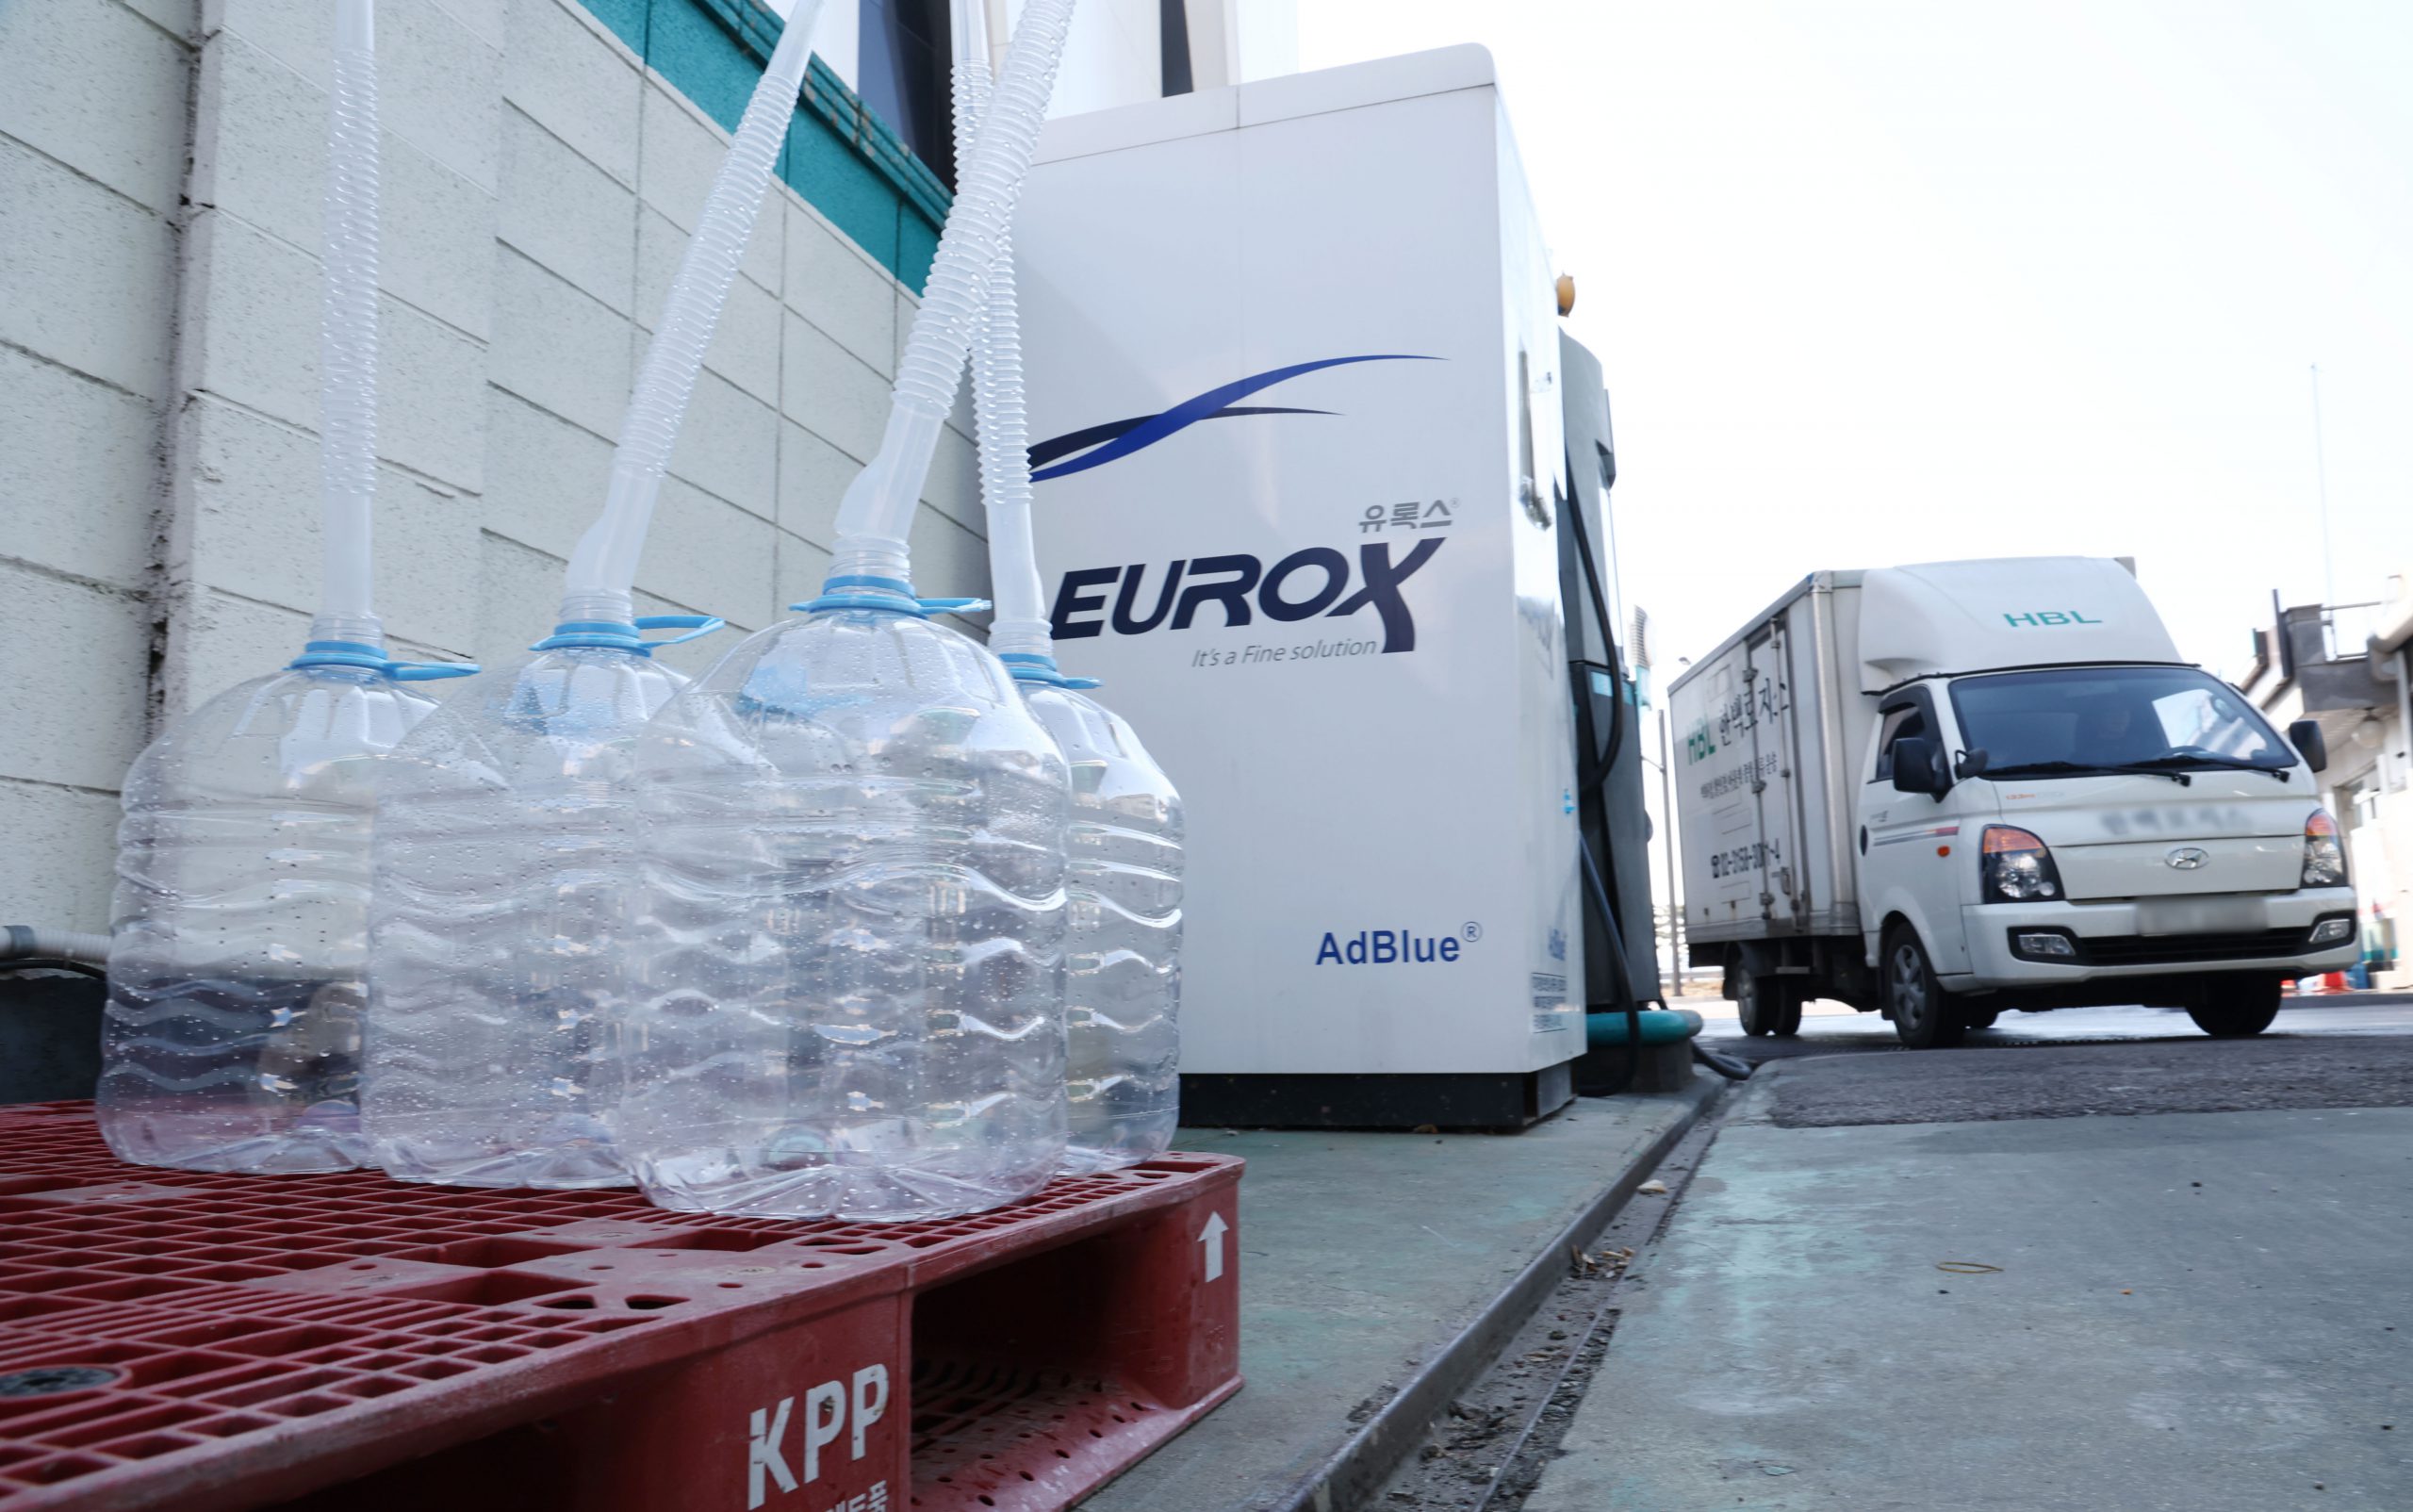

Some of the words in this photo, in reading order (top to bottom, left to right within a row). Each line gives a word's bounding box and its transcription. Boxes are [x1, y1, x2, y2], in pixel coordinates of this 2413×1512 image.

[1050, 536, 1447, 654] EUROX
[2002, 610, 2104, 628] HBL
[1223, 650, 1238, 666] a
[1241, 645, 1287, 664] Fine
[1289, 638, 1378, 661] solution
[747, 1363, 890, 1511] KPP
